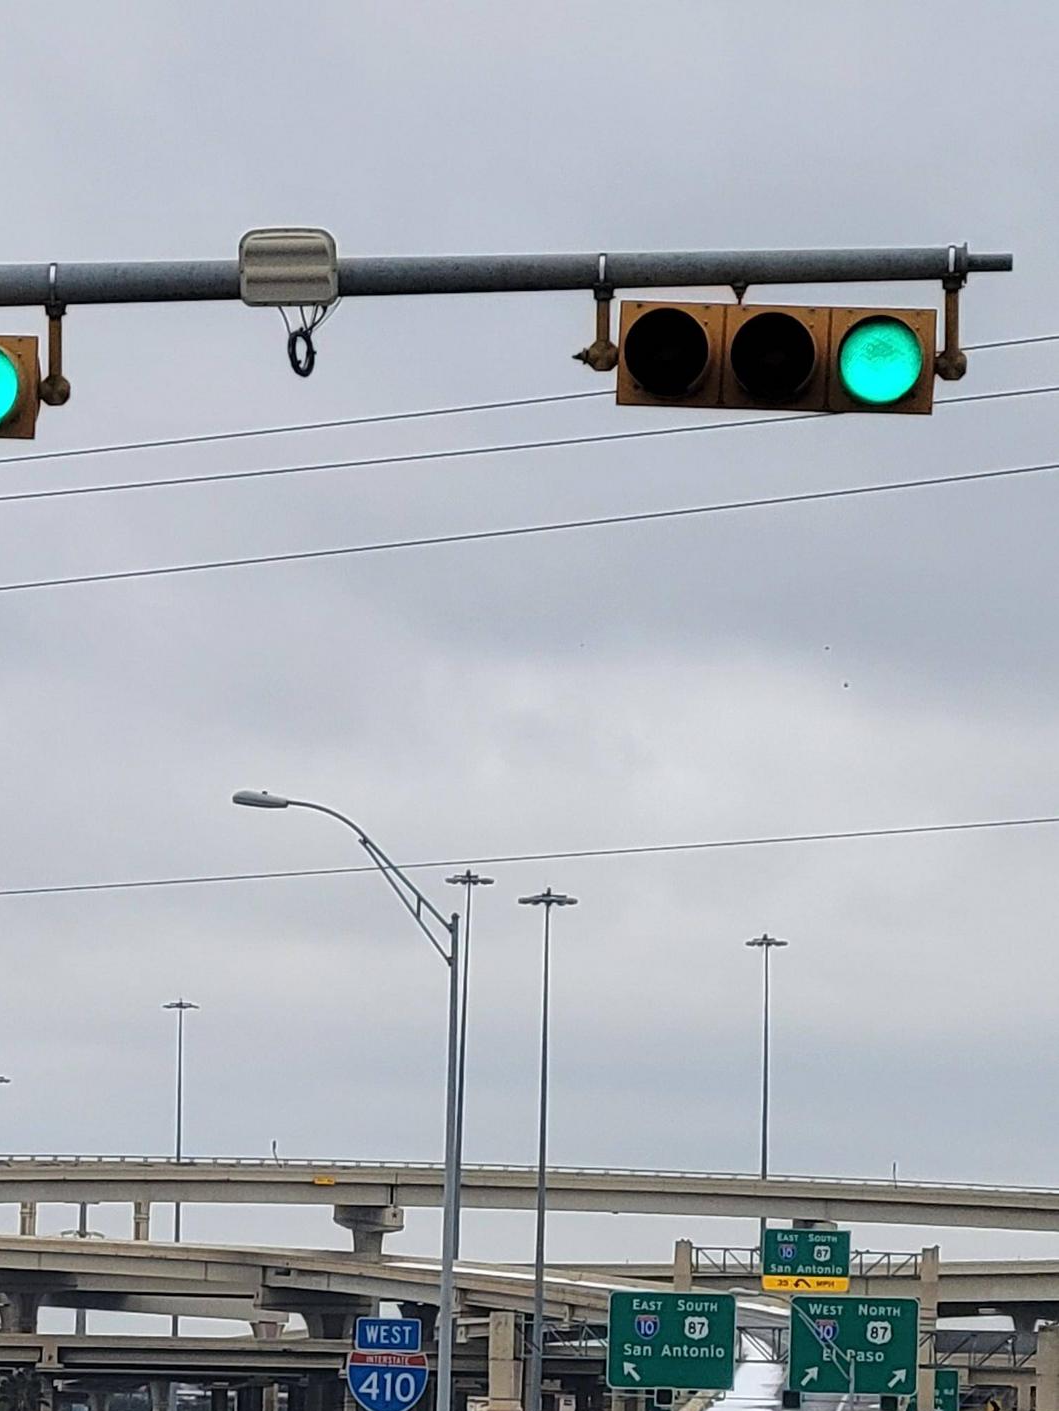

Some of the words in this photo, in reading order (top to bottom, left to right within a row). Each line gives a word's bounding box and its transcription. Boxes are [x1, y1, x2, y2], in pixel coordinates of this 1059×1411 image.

[776, 1233, 799, 1242] EAST
[808, 1233, 838, 1243] SOUTH
[782, 1247, 793, 1258] 10
[816, 1248, 829, 1259] 87
[770, 1263, 792, 1273] San
[796, 1264, 843, 1275] Antonio
[632, 1299, 662, 1311] EAST
[677, 1299, 718, 1312] SOUTH
[808, 1303, 844, 1316] WEST
[858, 1304, 901, 1317] NORTH
[641, 1320, 655, 1335] 10
[688, 1321, 705, 1335] 87
[870, 1326, 889, 1340] 87
[365, 1325, 413, 1345] WEST
[623, 1343, 652, 1356] San
[661, 1344, 725, 1358] Antonio
[846, 1349, 885, 1362] Paso
[365, 1354, 410, 1366] INTERSTATE
[358, 1371, 416, 1403] 410
